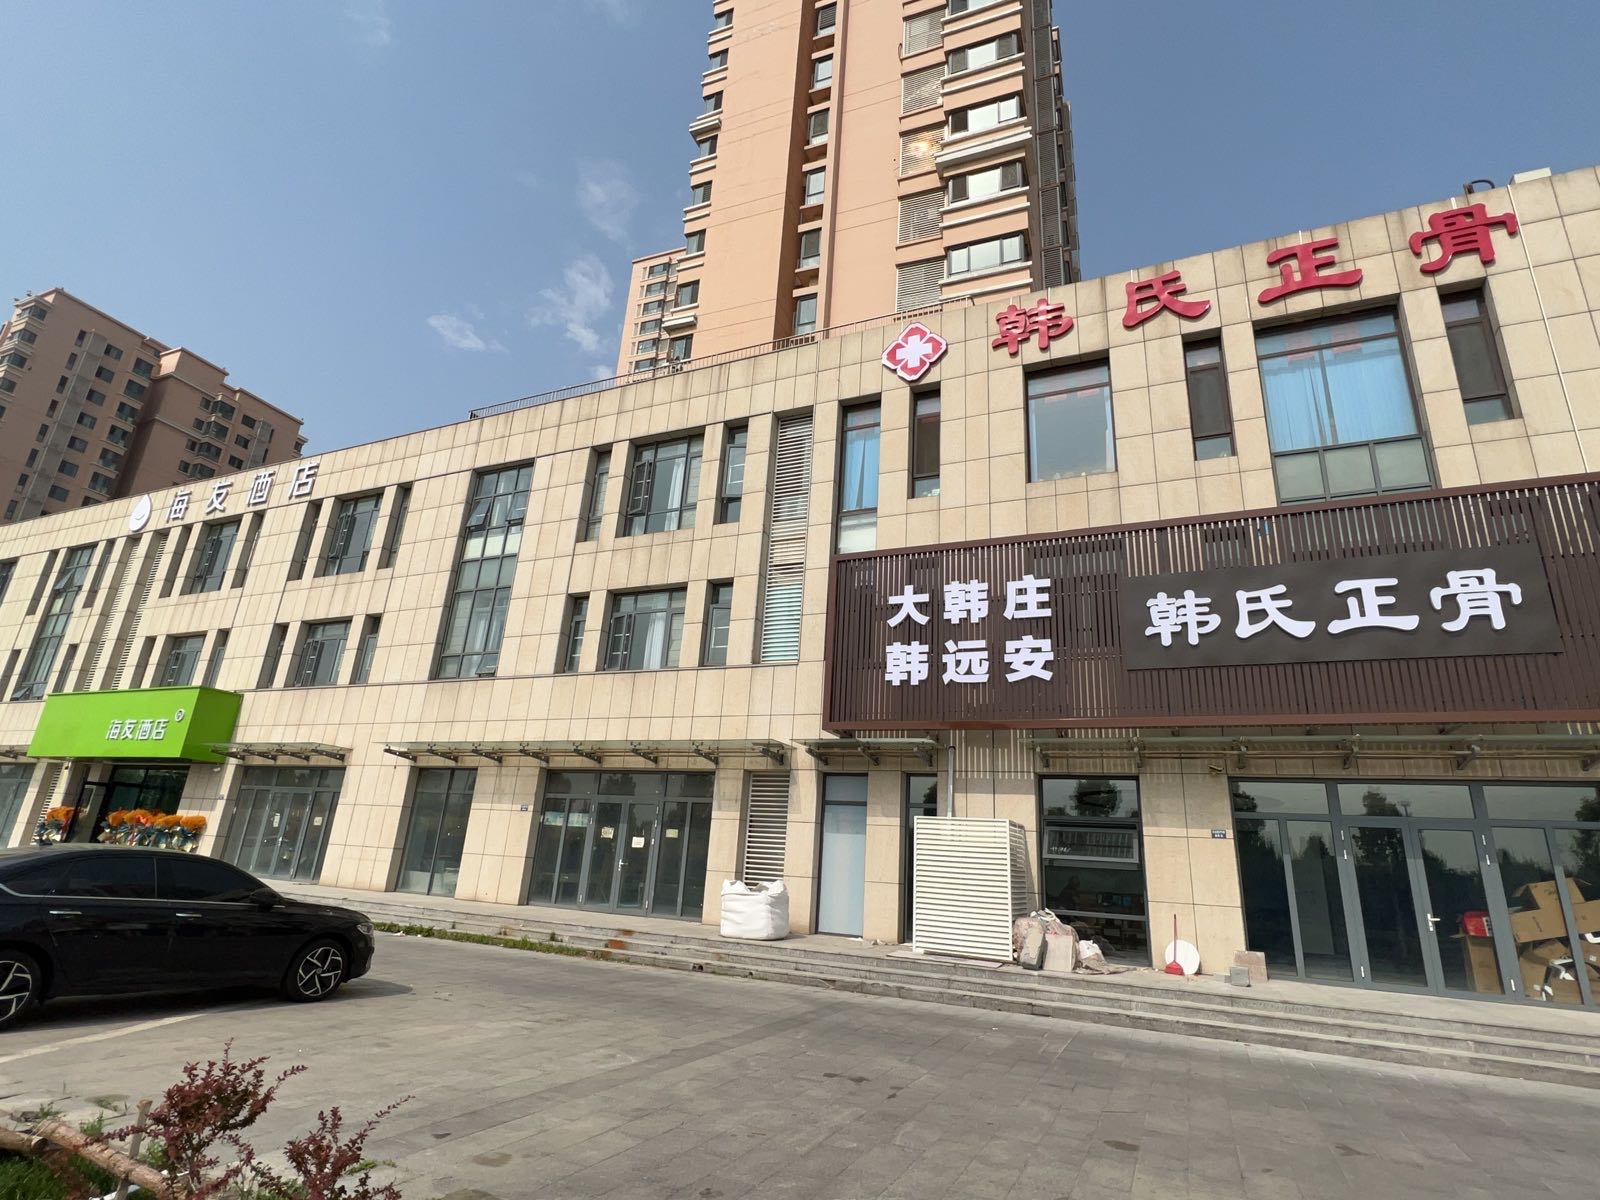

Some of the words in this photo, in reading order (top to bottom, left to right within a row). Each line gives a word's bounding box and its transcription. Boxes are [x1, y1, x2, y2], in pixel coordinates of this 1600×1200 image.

[991, 201, 1519, 356] 韩氏正骨
[168, 463, 319, 521] 海友酒店
[886, 575, 1052, 628] 大韩庄
[1145, 567, 1524, 648] 韩氏正骨
[885, 636, 1055, 686] 韩远安
[106, 719, 168, 740] 海友酒店
